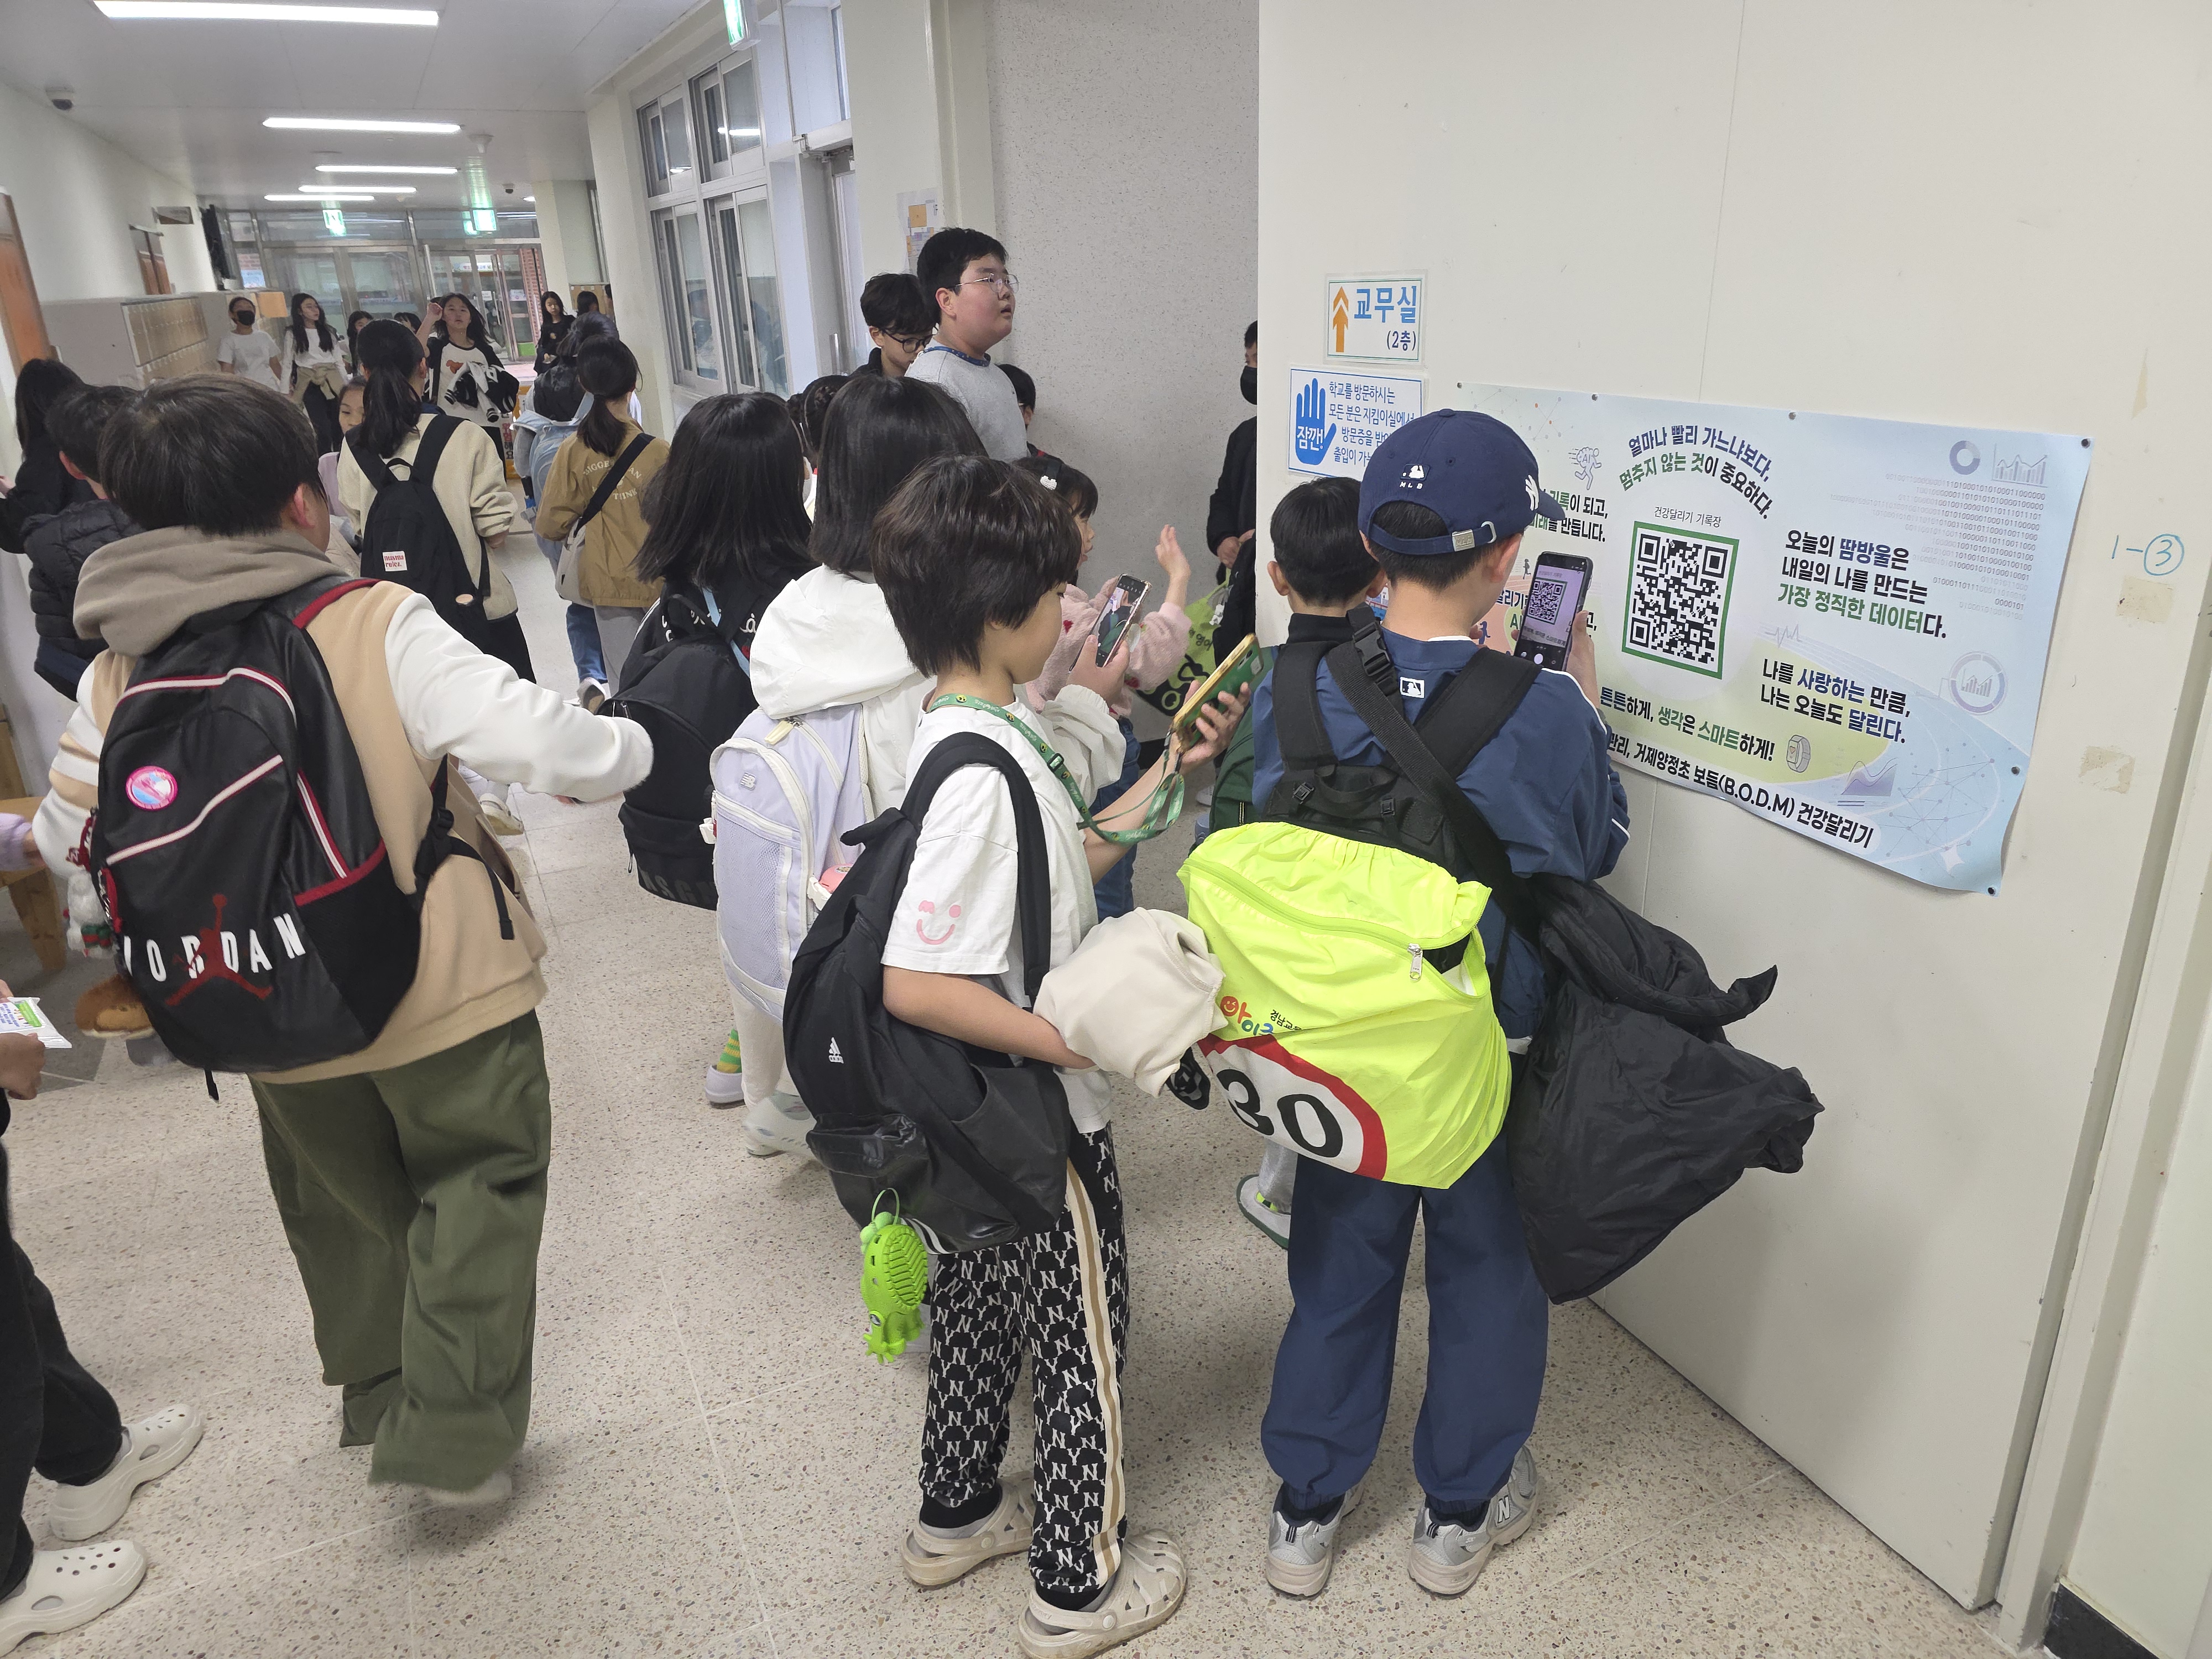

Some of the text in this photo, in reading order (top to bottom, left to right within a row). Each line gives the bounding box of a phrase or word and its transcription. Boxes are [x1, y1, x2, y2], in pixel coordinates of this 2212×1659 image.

[1354, 285, 1417, 324] 교무실
[1386, 330, 1416, 351] (2층)
[1329, 381, 1396, 404] 학교를 방문하시는
[1329, 404, 1344, 420] 모든
[1345, 405, 1362, 423] 분은
[1297, 425, 1324, 451] 잠깐!
[1342, 426, 1374, 447] 방문증을
[1333, 446, 1356, 465] 출입이
[1629, 425, 1772, 482] 얼마나 빨리 가느냐보다,
[1400, 481, 1423, 489] MLB
[1619, 451, 1773, 519] 멈추지 않는 것이 중요하다.
[1583, 496, 1608, 519] 되고,
[1654, 506, 1722, 528] 건강달리기 기록장
[1561, 517, 1605, 542] 만듭니다.
[1785, 529, 1909, 572] 오늘의 땀방울은
[1781, 556, 1928, 605] 내일의 나를 만드는
[1777, 582, 1947, 639] 가장 정직한 데이터다.
[1994, 597, 2024, 610] 0000101
[1762, 658, 1912, 718] 나를 사랑하는 만큼,
[1600, 686, 1776, 761] 튼튼하게, 생각은 스마트하게!
[1760, 684, 1906, 744] 나는 오늘도 달린다.
[1633, 742, 1691, 780] 거제양정초
[1693, 765, 1795, 818] 보듬(B.O.D.M)
[1797, 801, 1874, 848] 건강달리기
[1217, 1068, 1343, 1158] 30
[1497, 1494, 1510, 1524] N
